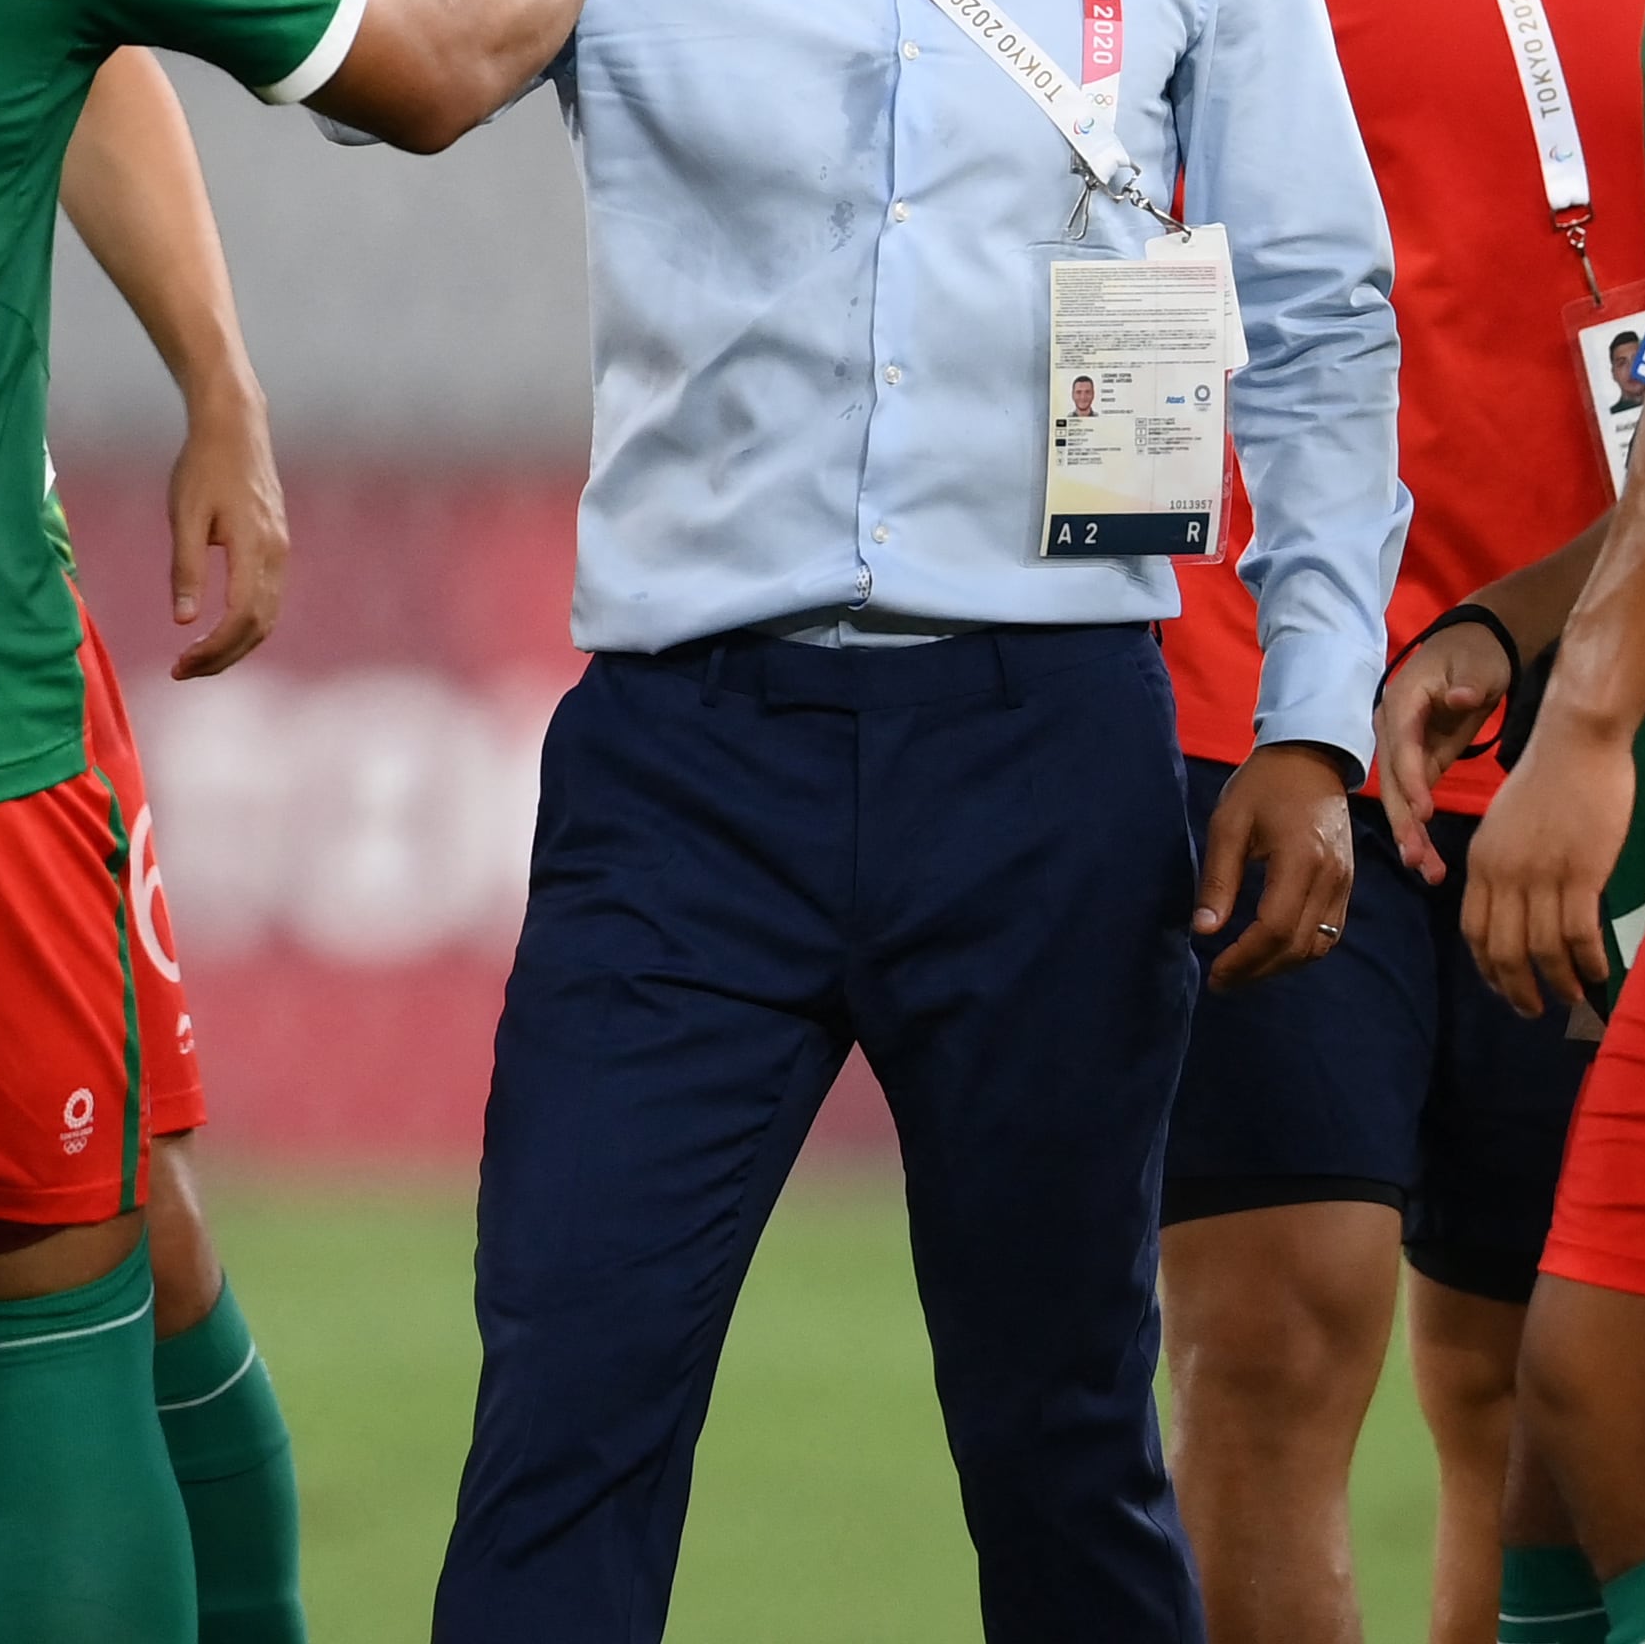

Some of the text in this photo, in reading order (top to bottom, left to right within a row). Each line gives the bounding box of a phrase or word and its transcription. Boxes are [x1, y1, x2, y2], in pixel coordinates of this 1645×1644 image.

[1092, 5, 1114, 65] 2020
[997, 34, 1063, 103] TOKYO
[1524, 39, 1561, 119] TOKYO
[1057, 521, 1201, 544] A 2 R
